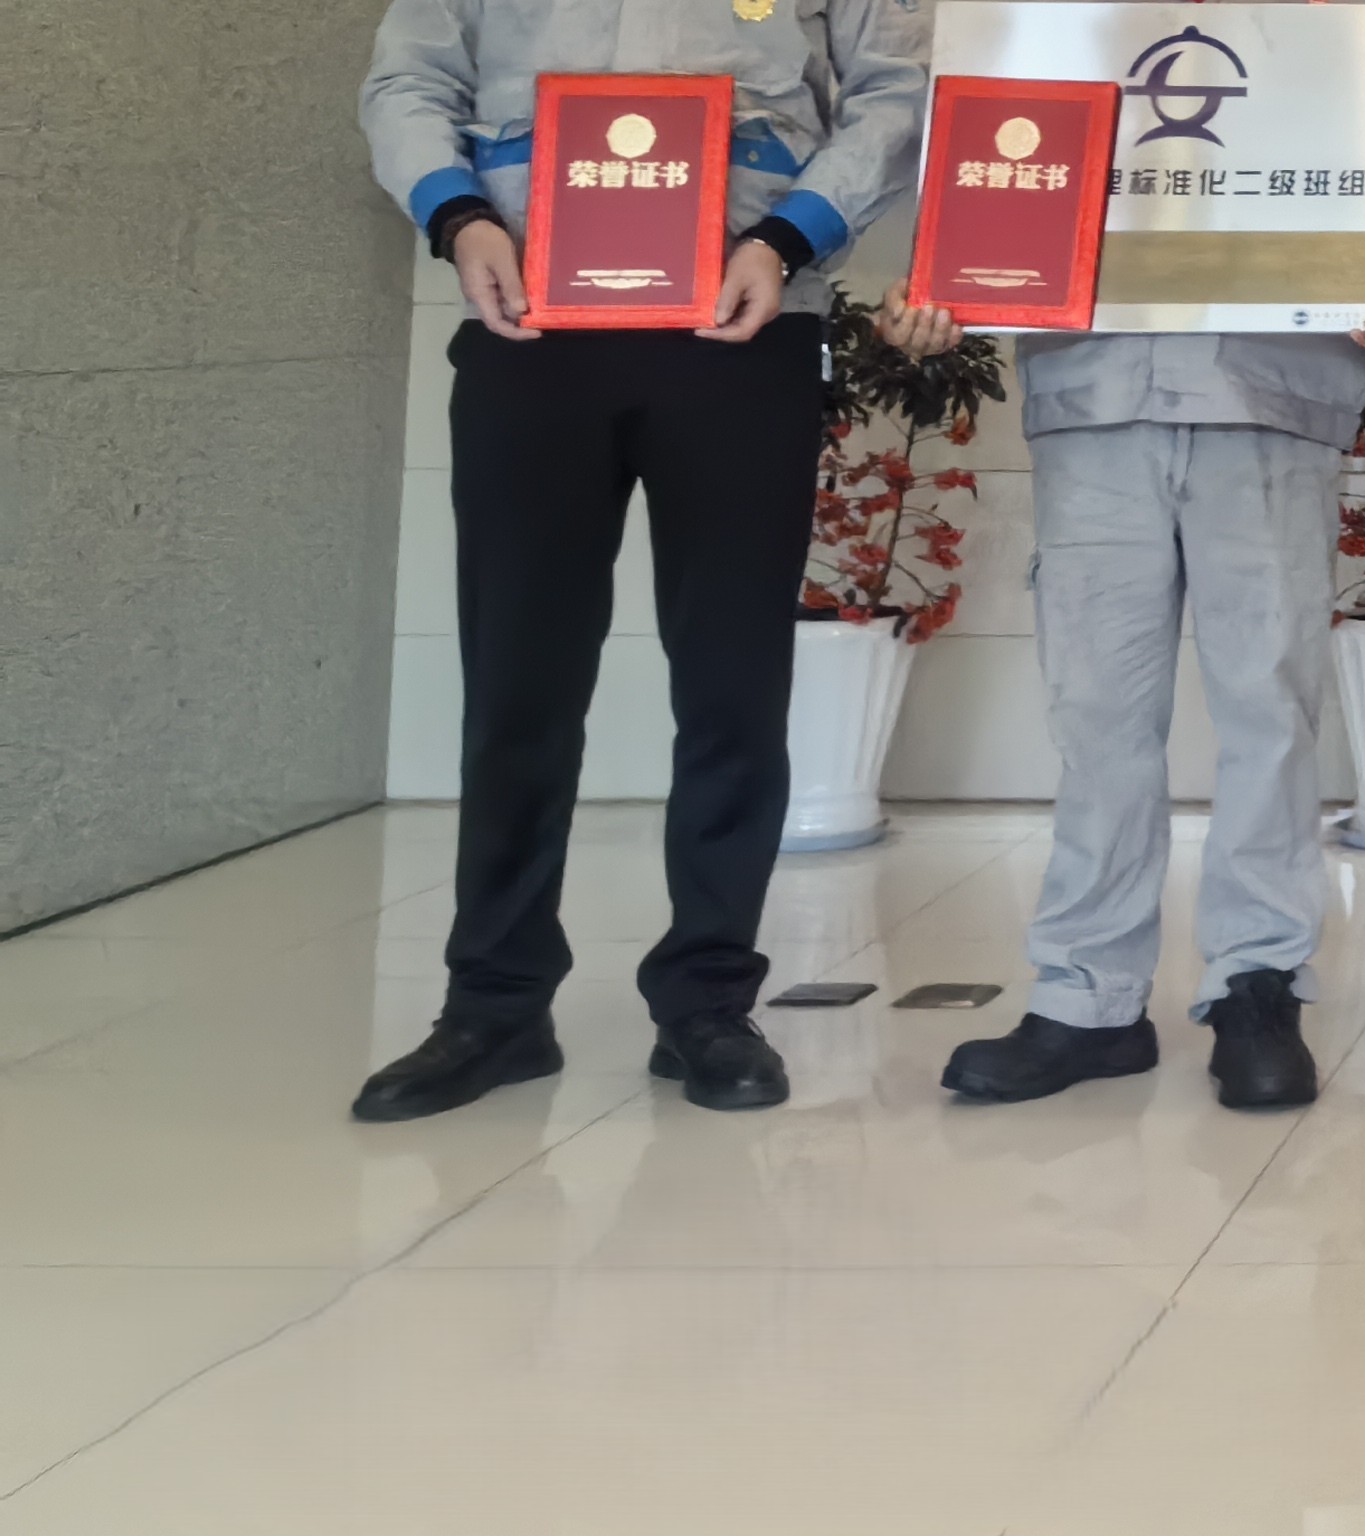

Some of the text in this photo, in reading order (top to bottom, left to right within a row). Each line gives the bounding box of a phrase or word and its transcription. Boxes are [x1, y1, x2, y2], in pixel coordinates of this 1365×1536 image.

[567, 160, 690, 188] 荣誉证书
[955, 161, 1070, 191] 荣誉证书
